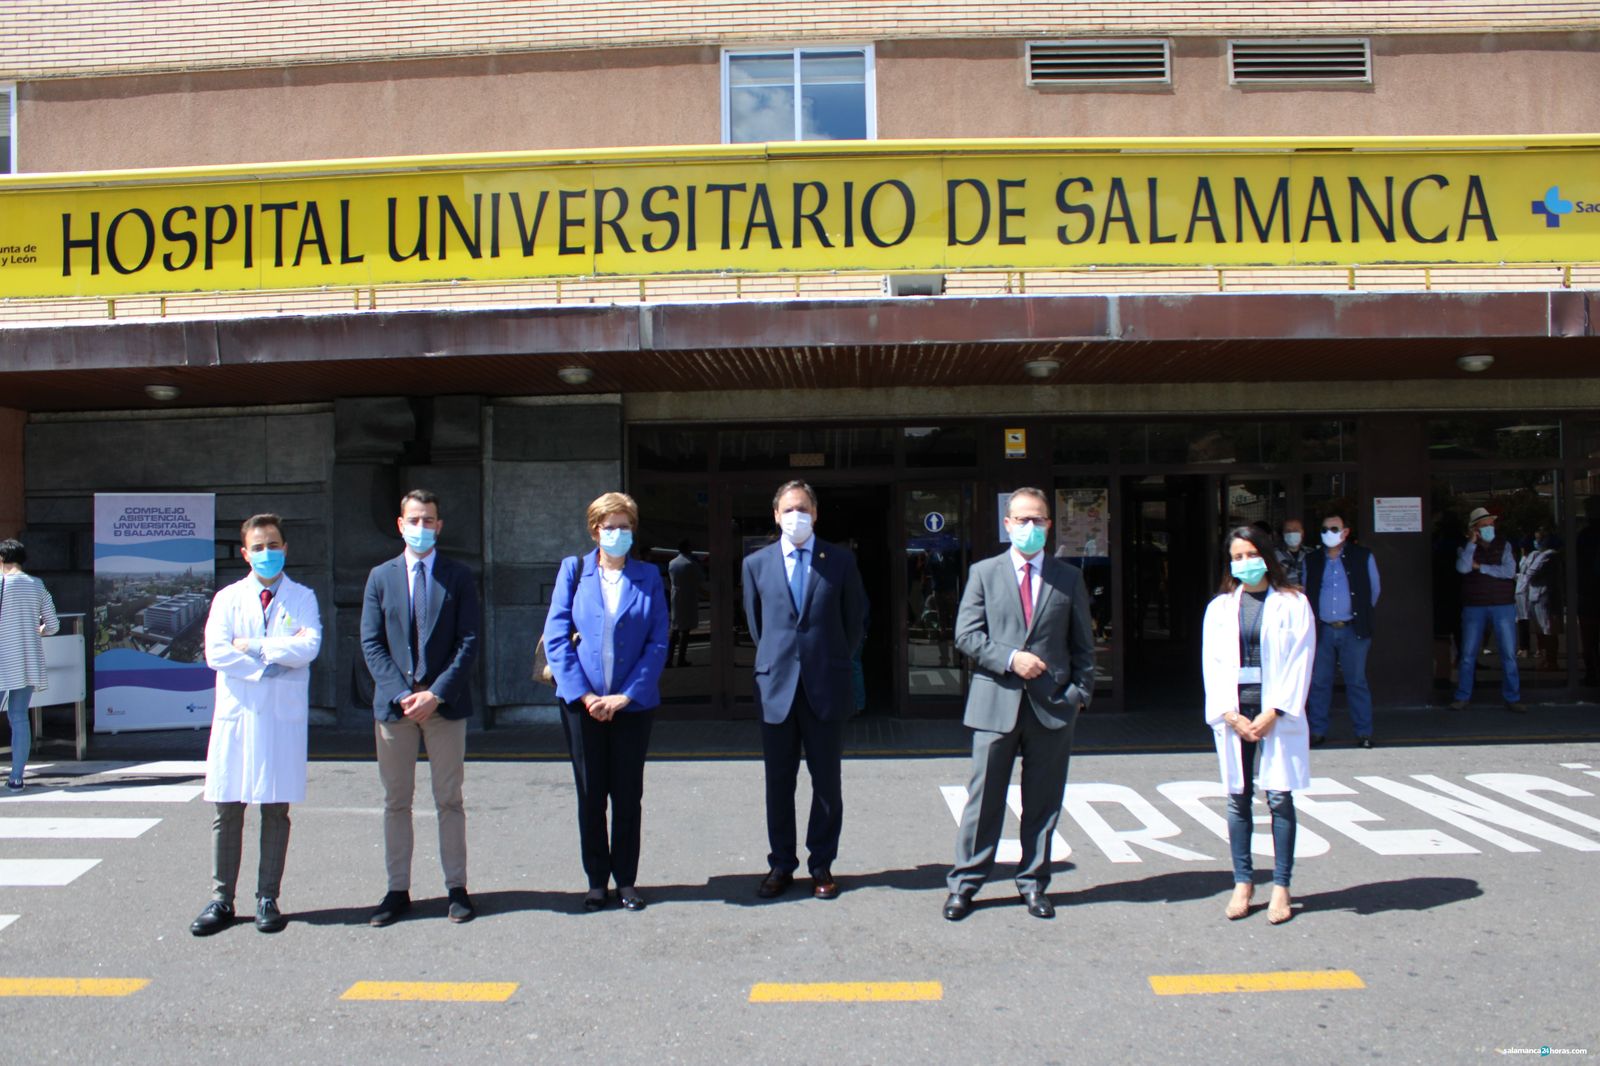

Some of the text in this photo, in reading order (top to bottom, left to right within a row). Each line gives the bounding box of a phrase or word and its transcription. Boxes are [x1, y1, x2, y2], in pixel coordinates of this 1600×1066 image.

[62, 174, 1499, 277] HOSPITAL UNIVERSITARIO DE SALAMANCA
[23, 244, 37, 253] de
[1, 254, 37, 267] y León
[124, 529, 196, 537] SALAMANCA
